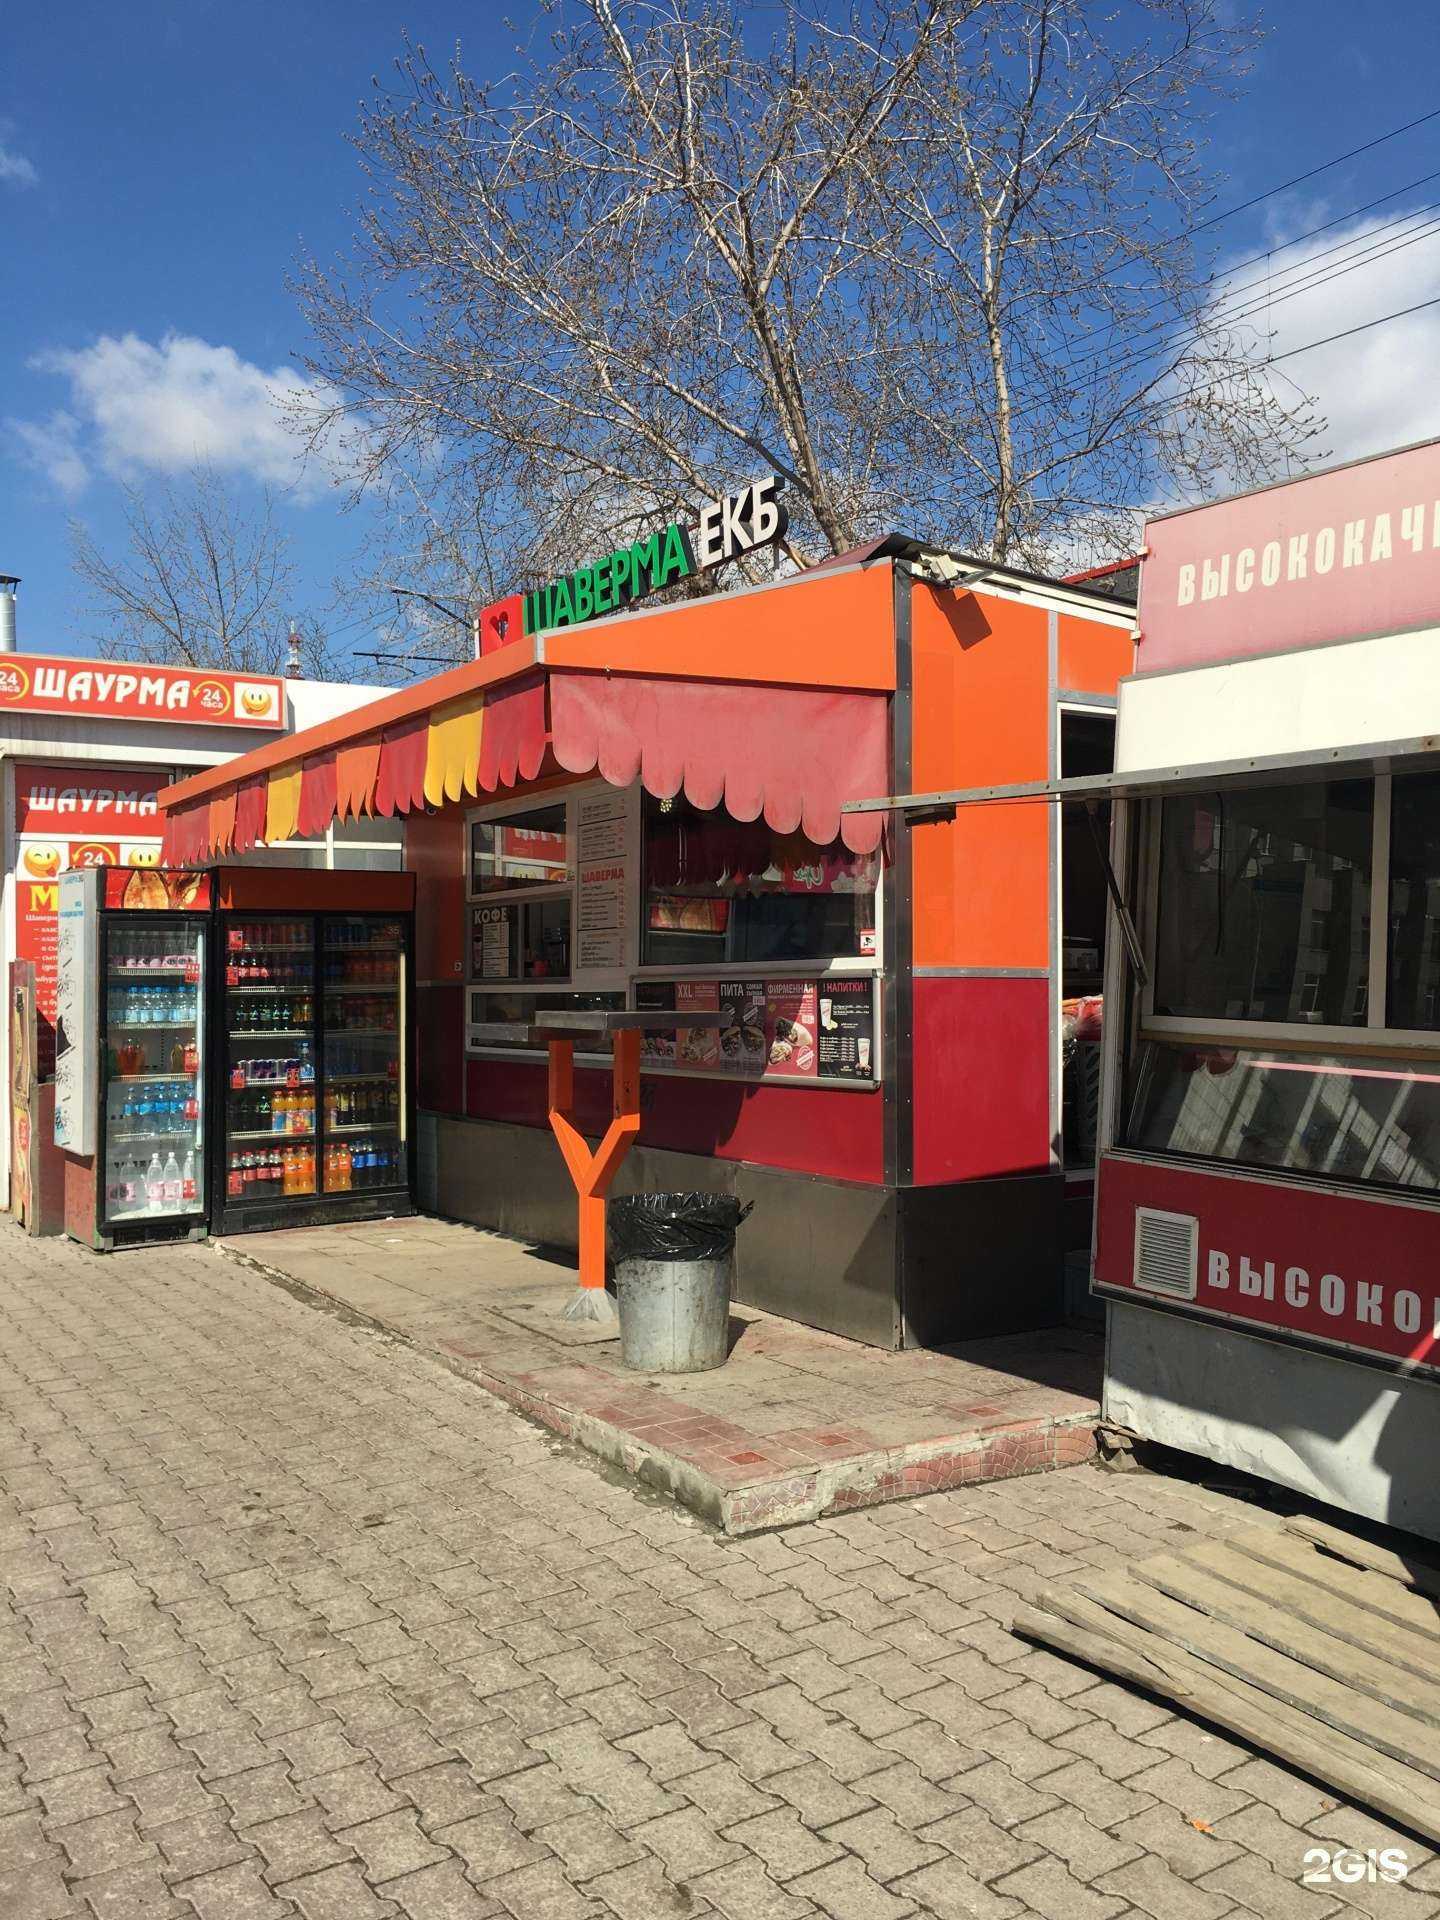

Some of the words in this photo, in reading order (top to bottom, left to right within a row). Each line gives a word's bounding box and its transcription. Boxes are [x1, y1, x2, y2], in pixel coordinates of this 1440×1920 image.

[523, 520, 694, 636] ШАВЕРМА
[700, 475, 788, 568] ЕКБ
[33, 667, 191, 709] ШАУРМА
[203, 688, 221, 701] 24
[29, 787, 157, 817] ШАУРМА
[84, 852, 104, 866] 24
[474, 907, 508, 925] КОФЕ
[678, 985, 693, 998] XXL
[720, 983, 744, 998] ПИТА
[767, 982, 814, 994] ФИРМЕННАЯ
